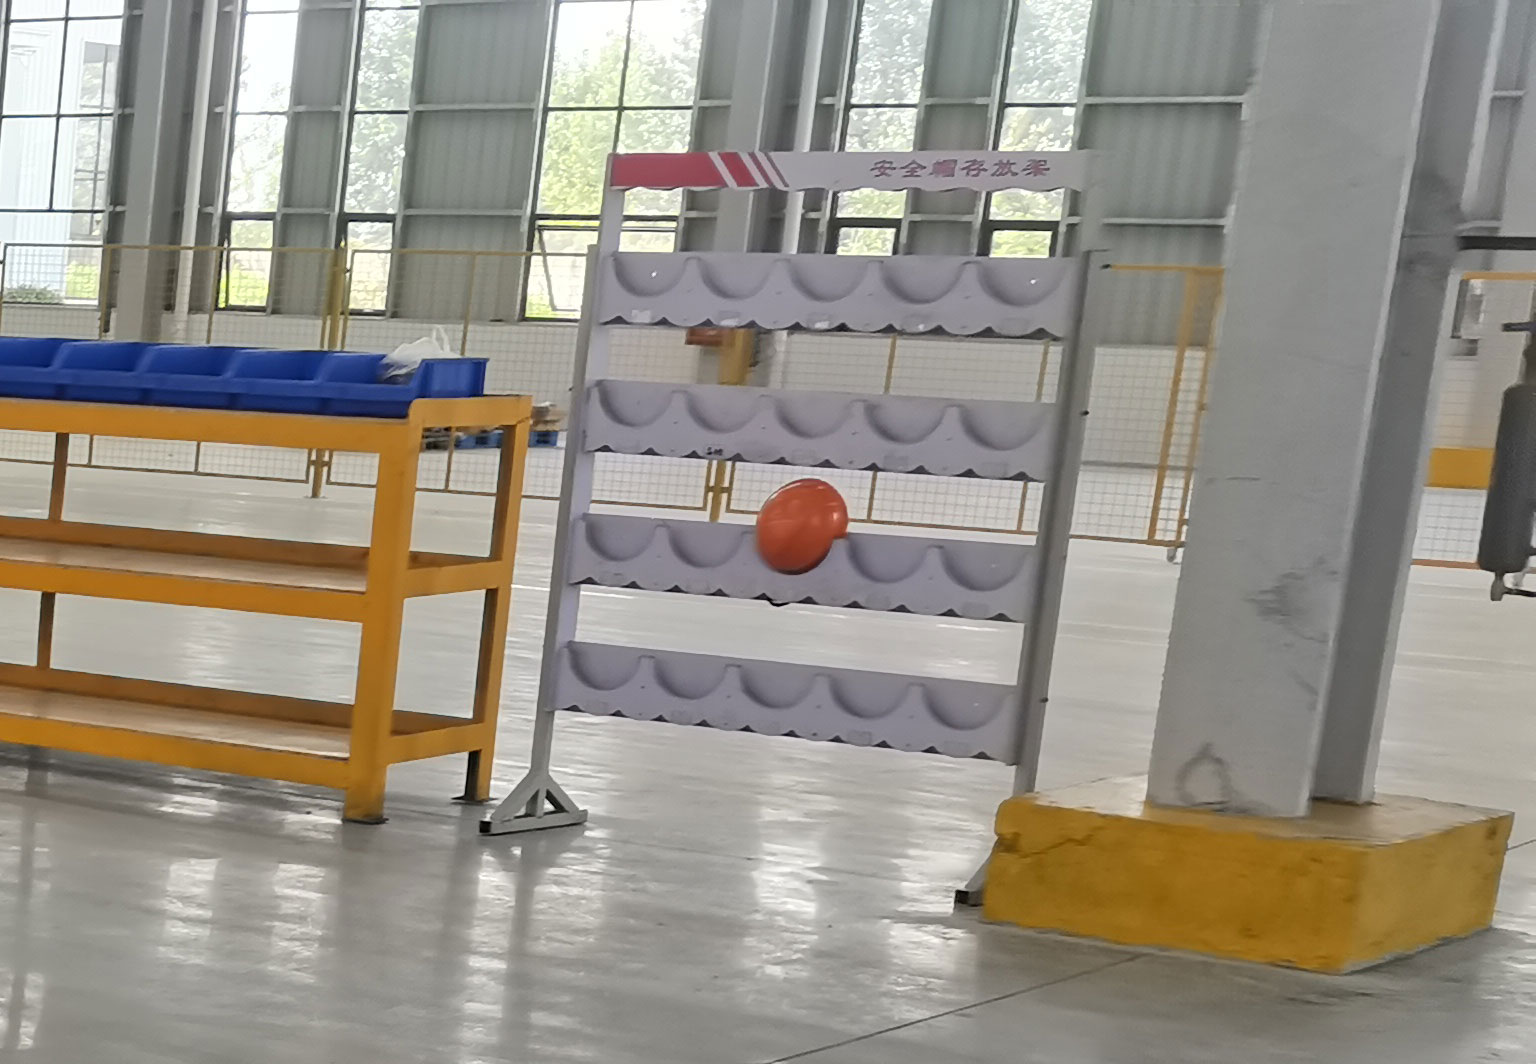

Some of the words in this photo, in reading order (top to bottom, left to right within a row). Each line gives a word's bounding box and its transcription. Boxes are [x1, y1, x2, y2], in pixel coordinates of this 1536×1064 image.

[870, 158, 1051, 178] 安全帽存放架
